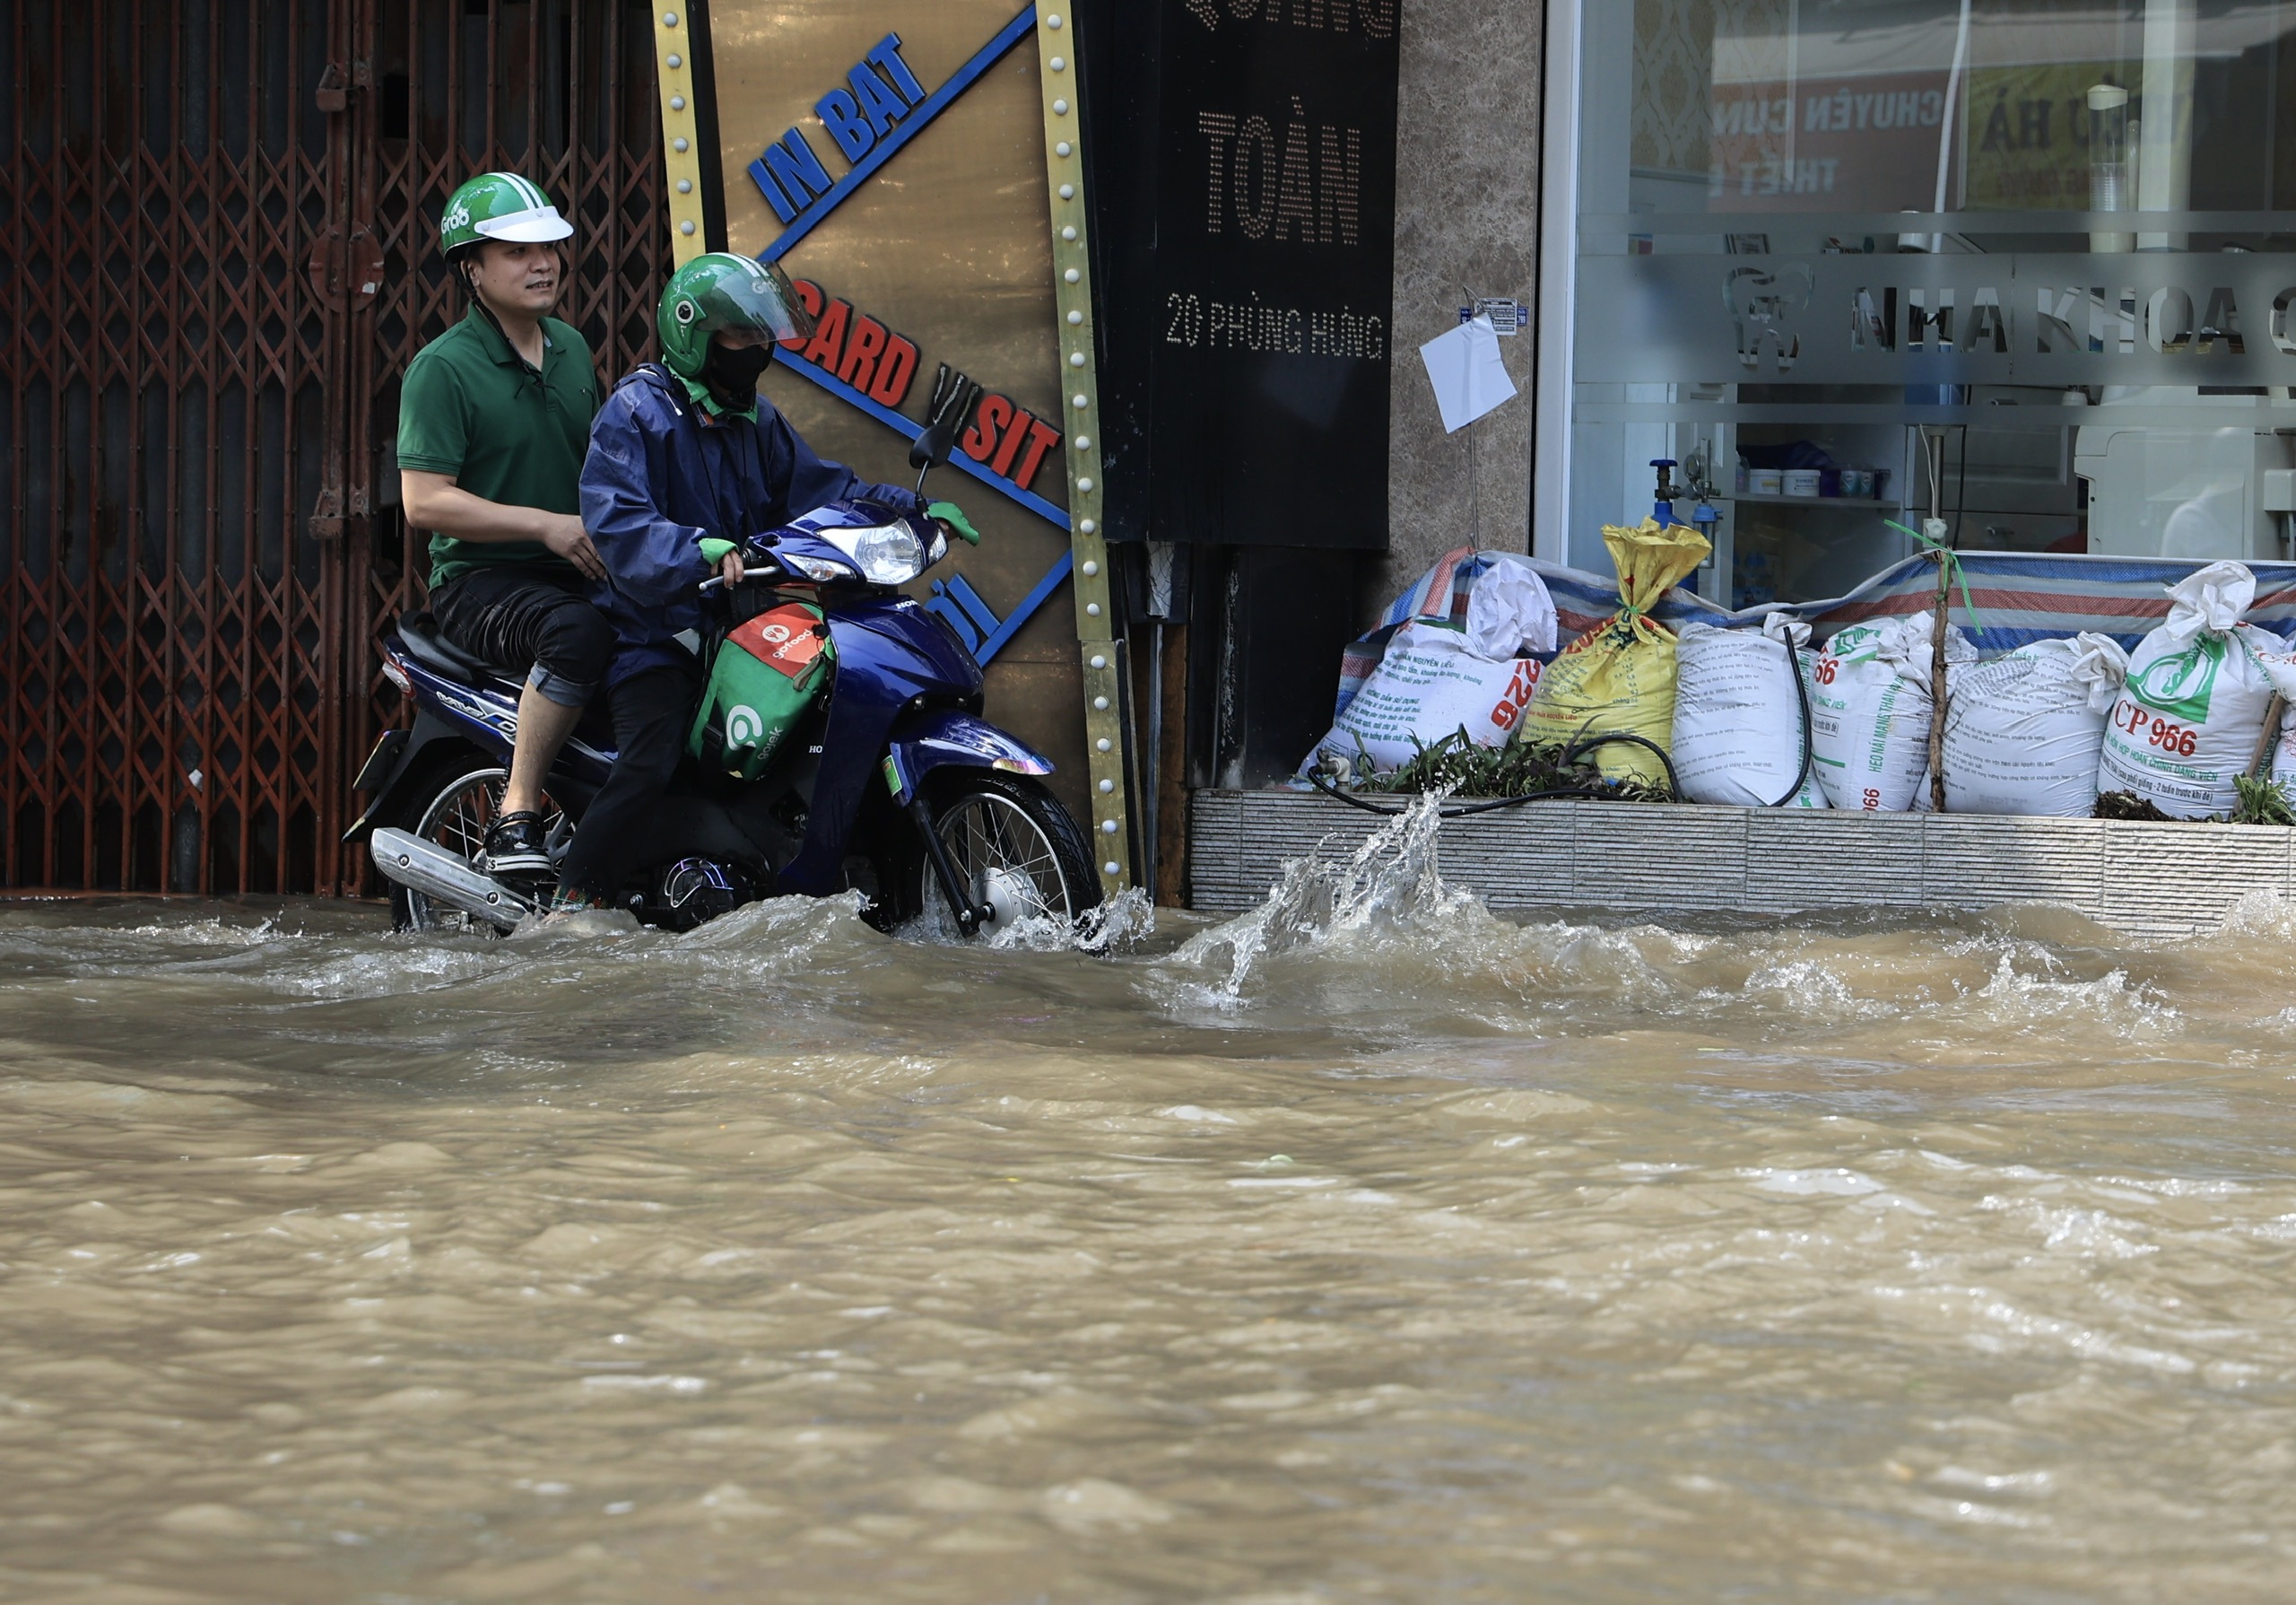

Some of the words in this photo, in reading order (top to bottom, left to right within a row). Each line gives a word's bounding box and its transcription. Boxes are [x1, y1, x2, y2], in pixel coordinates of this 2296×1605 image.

[748, 125, 834, 223] IN
[814, 31, 926, 163] BAT
[1199, 95, 1361, 246] TOÀN
[440, 206, 470, 234] Grab
[1167, 292, 1204, 348] 20
[1211, 291, 1302, 353] PHÙNG
[1851, 287, 2009, 353] NHA
[2036, 286, 2246, 353] KHOA
[777, 278, 921, 408] CARD
[772, 629, 813, 660] gofood
[1879, 693, 1894, 712] THAI
[757, 726, 784, 760] gojek
[1874, 714, 1891, 740] MANG
[2115, 699, 2150, 736] CP
[2148, 718, 2197, 757] 966
[1868, 739, 1885, 755] NÁI
[1868, 754, 1883, 773] HEO
[2137, 777, 2153, 790] giống
[2161, 783, 2175, 795] tuần
